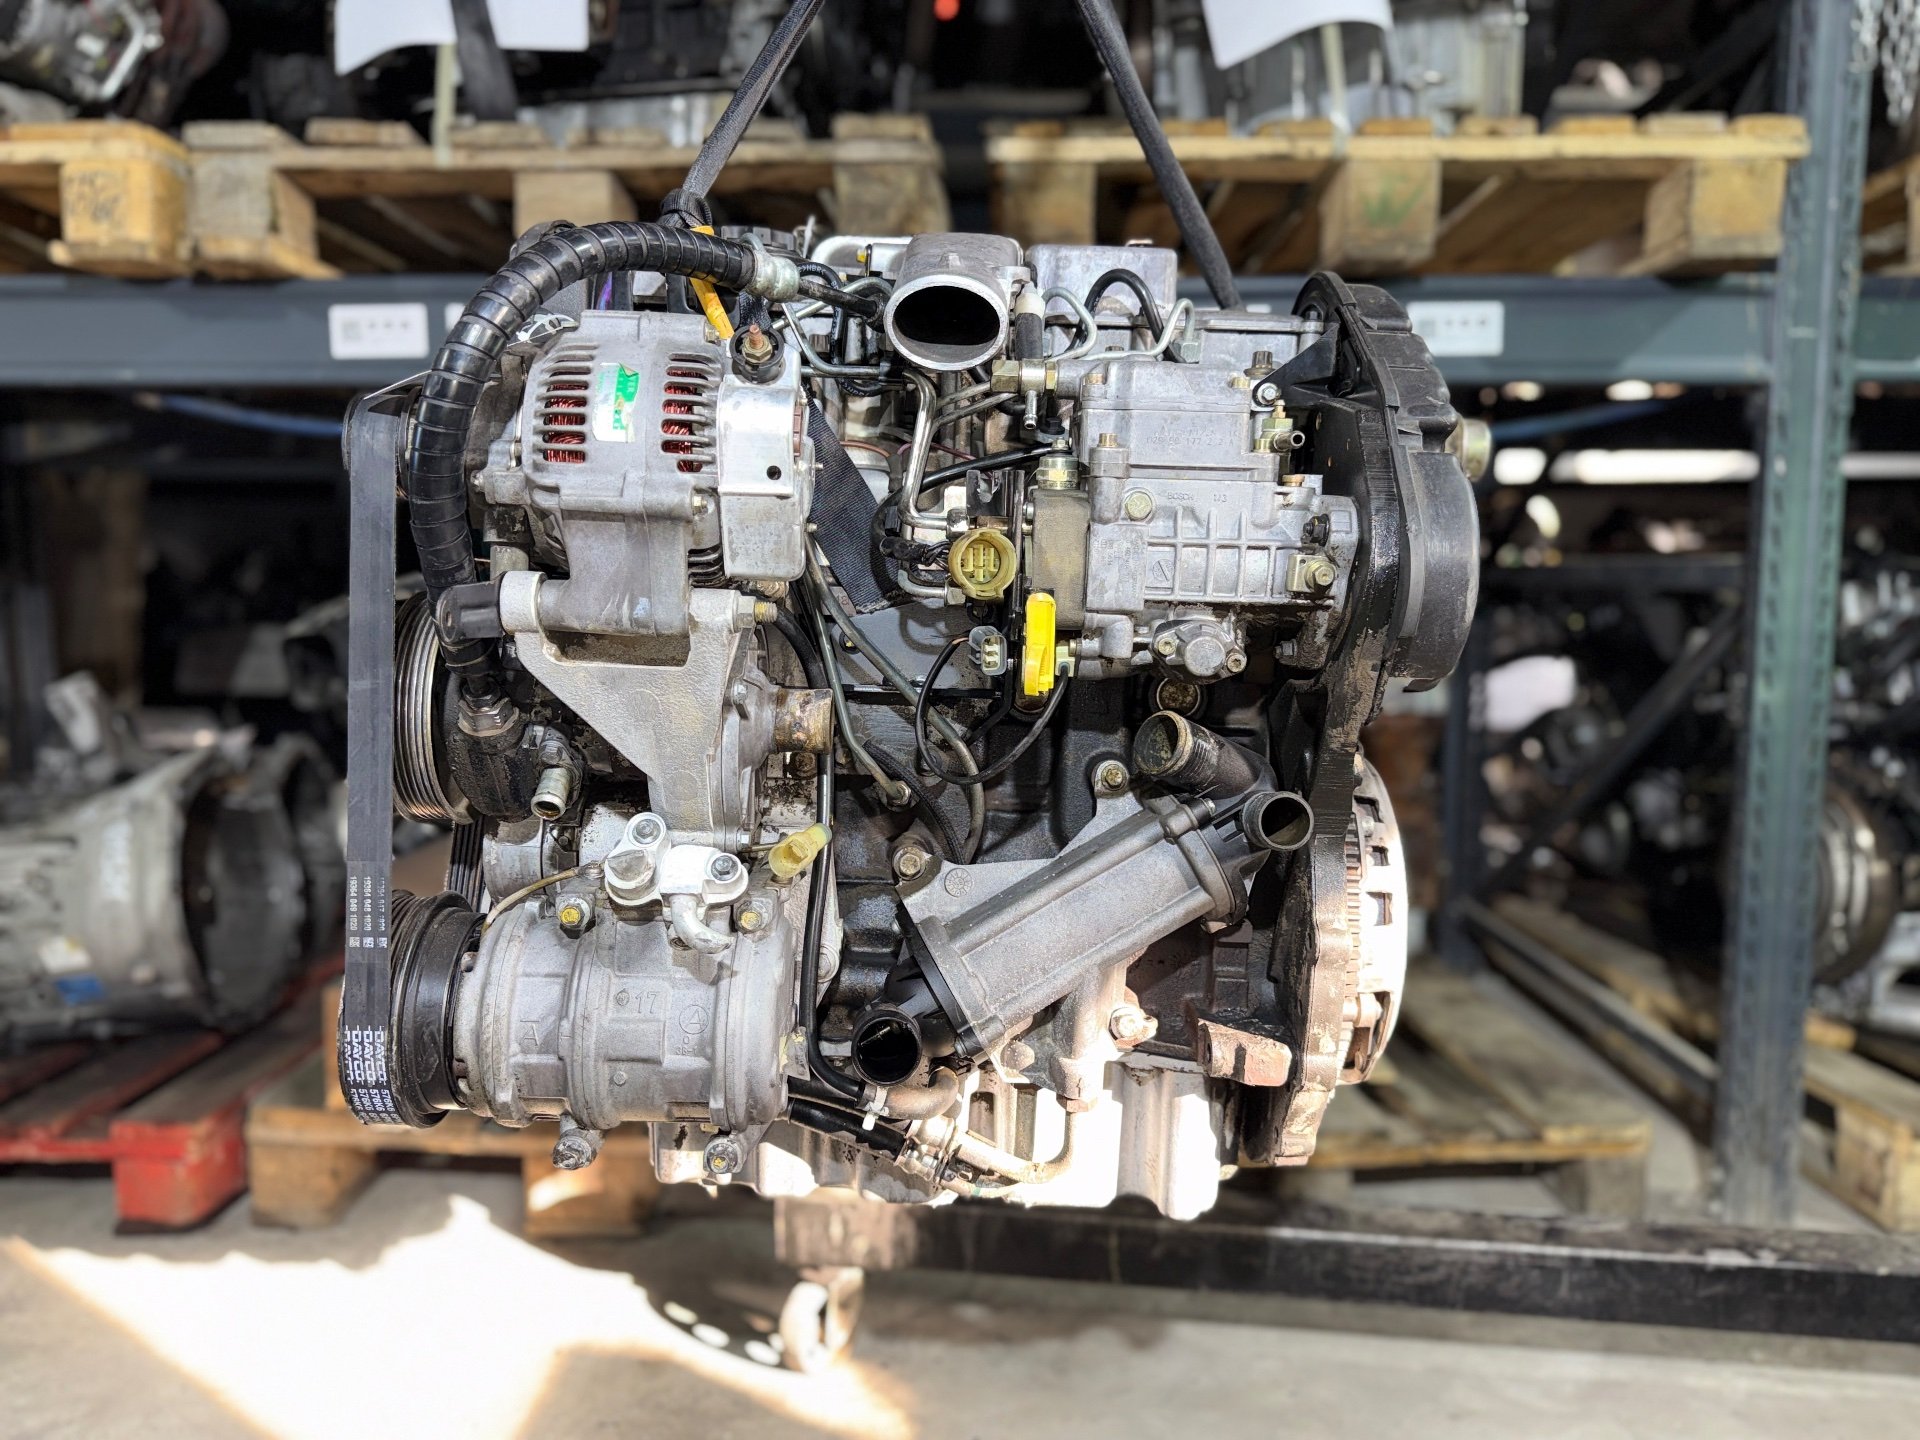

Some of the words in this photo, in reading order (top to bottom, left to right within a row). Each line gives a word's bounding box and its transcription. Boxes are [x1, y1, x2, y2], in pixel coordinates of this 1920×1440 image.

[352, 1027, 365, 1085] DAYCO
[363, 1027, 376, 1085] DAYCO
[374, 1028, 387, 1085] DAYCO
